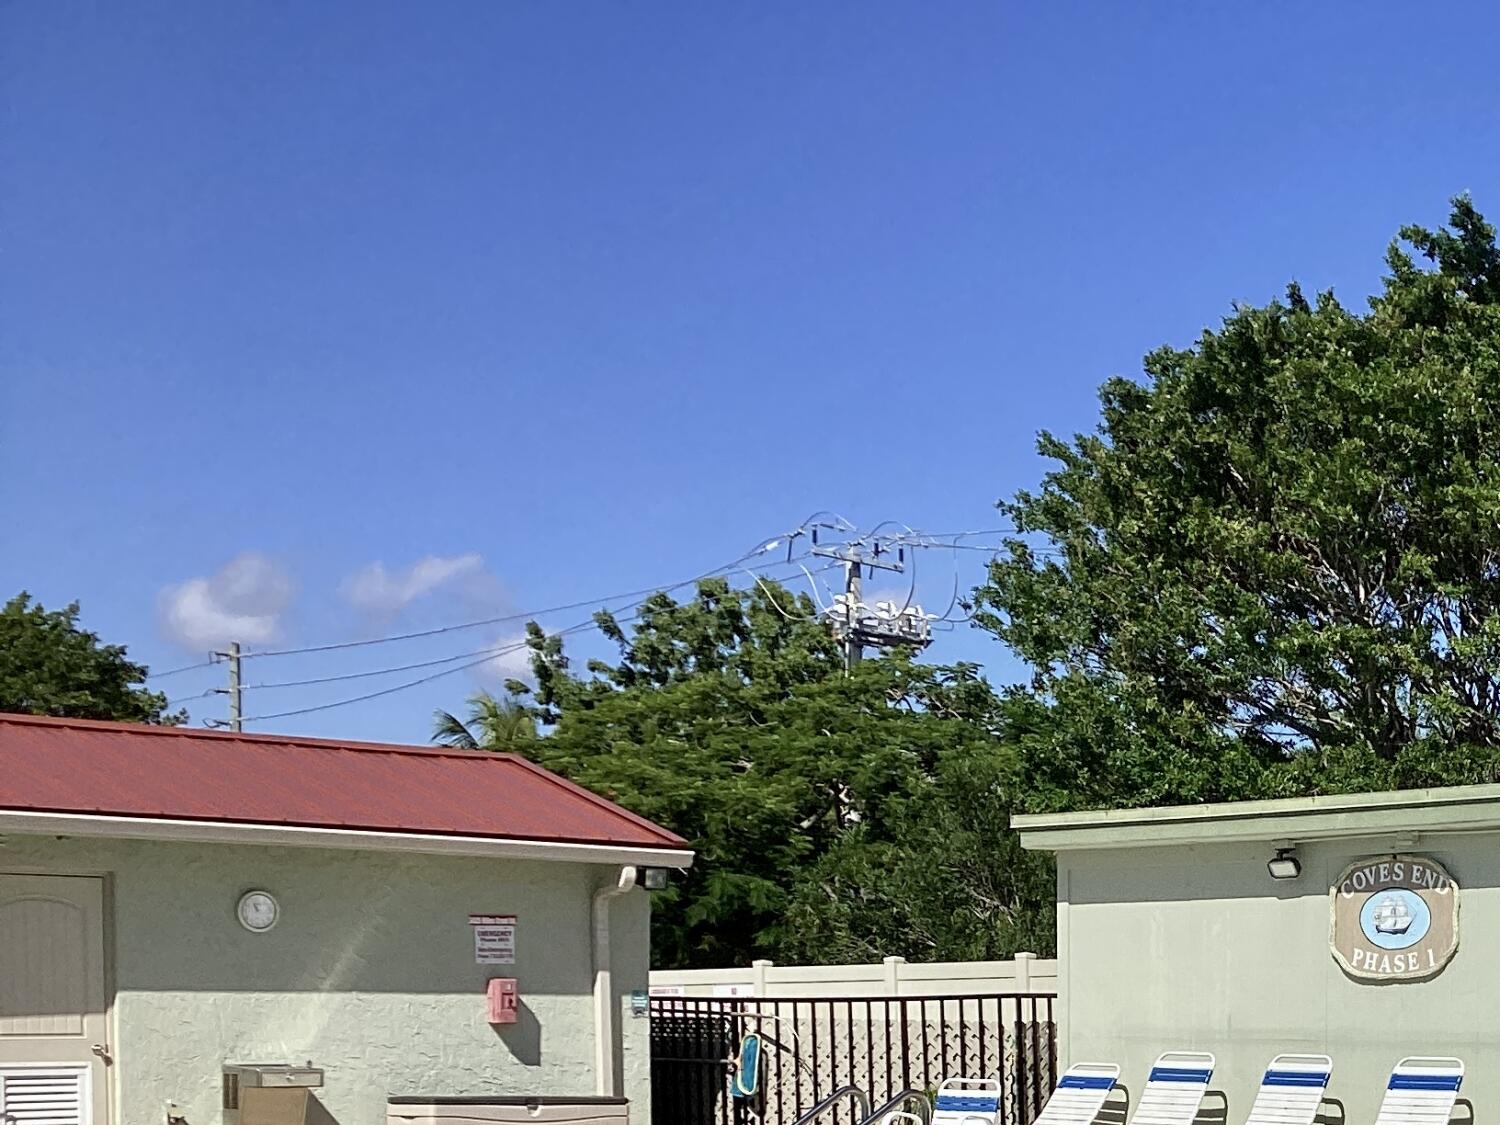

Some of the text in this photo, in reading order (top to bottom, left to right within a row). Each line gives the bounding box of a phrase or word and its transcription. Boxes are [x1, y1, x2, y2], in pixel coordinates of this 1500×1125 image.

[1340, 863, 1451, 899] COVES END
[1351, 947, 1420, 973] PHASE
